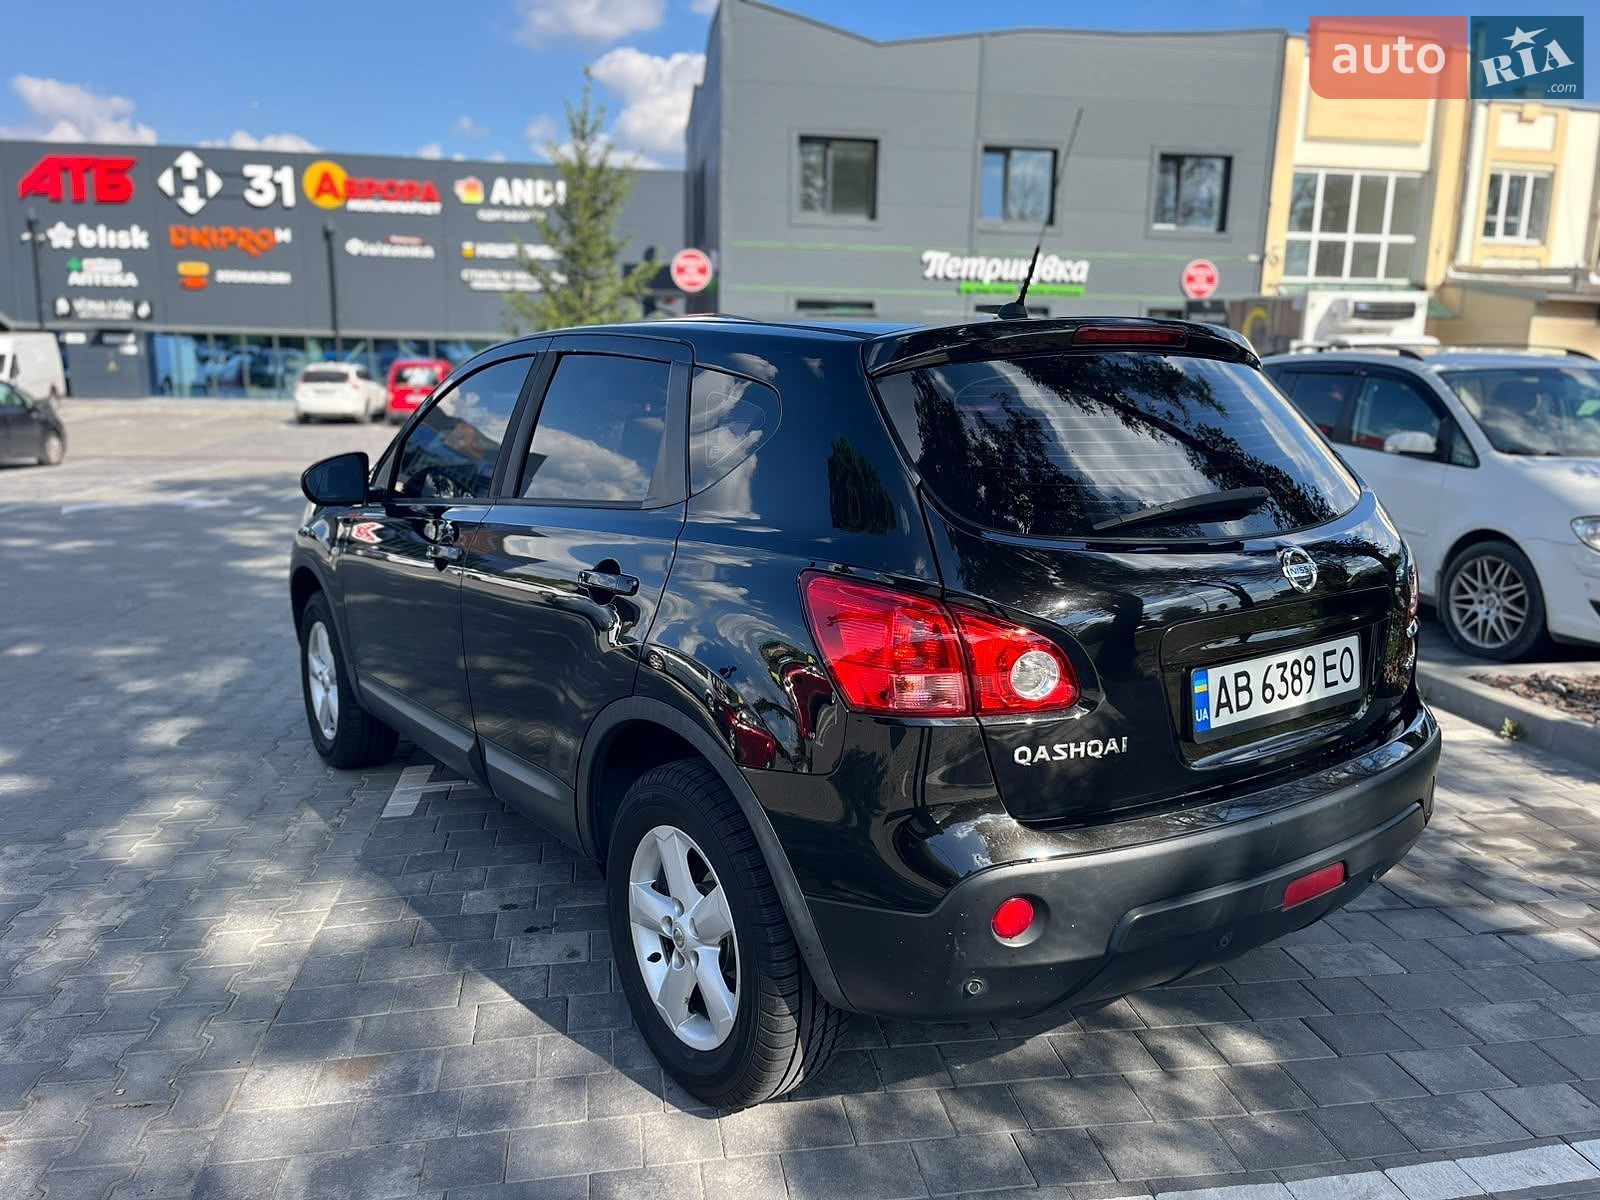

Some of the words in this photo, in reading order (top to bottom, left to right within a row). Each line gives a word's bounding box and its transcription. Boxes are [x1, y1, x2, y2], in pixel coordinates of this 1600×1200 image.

[18, 154, 138, 204] АТБ
[243, 164, 296, 208] 31
[1214, 669, 1253, 718] AB
[1261, 655, 1317, 704] 6389
[1323, 646, 1355, 687] EO
[1195, 709, 1209, 723] UA
[1013, 736, 1129, 767] QASHQAI
